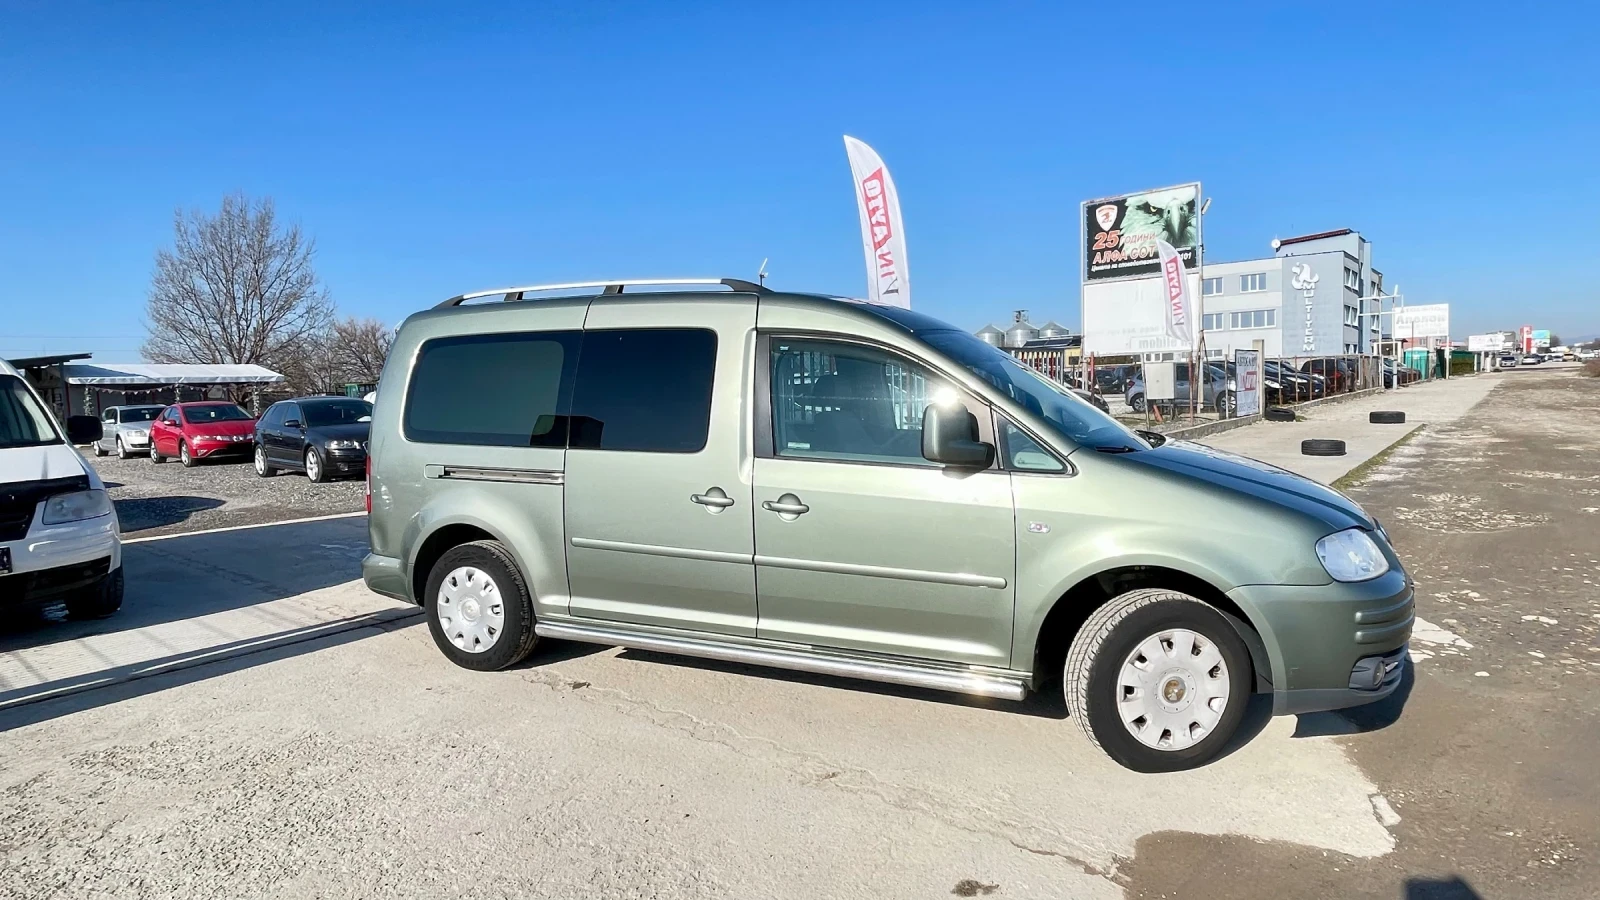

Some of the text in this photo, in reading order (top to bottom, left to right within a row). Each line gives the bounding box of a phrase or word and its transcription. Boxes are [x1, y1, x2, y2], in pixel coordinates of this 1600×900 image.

[1092, 229, 1121, 250] 25
[1092, 249, 1128, 264] АЛФА
[1303, 282, 1316, 352] MULTITERM
